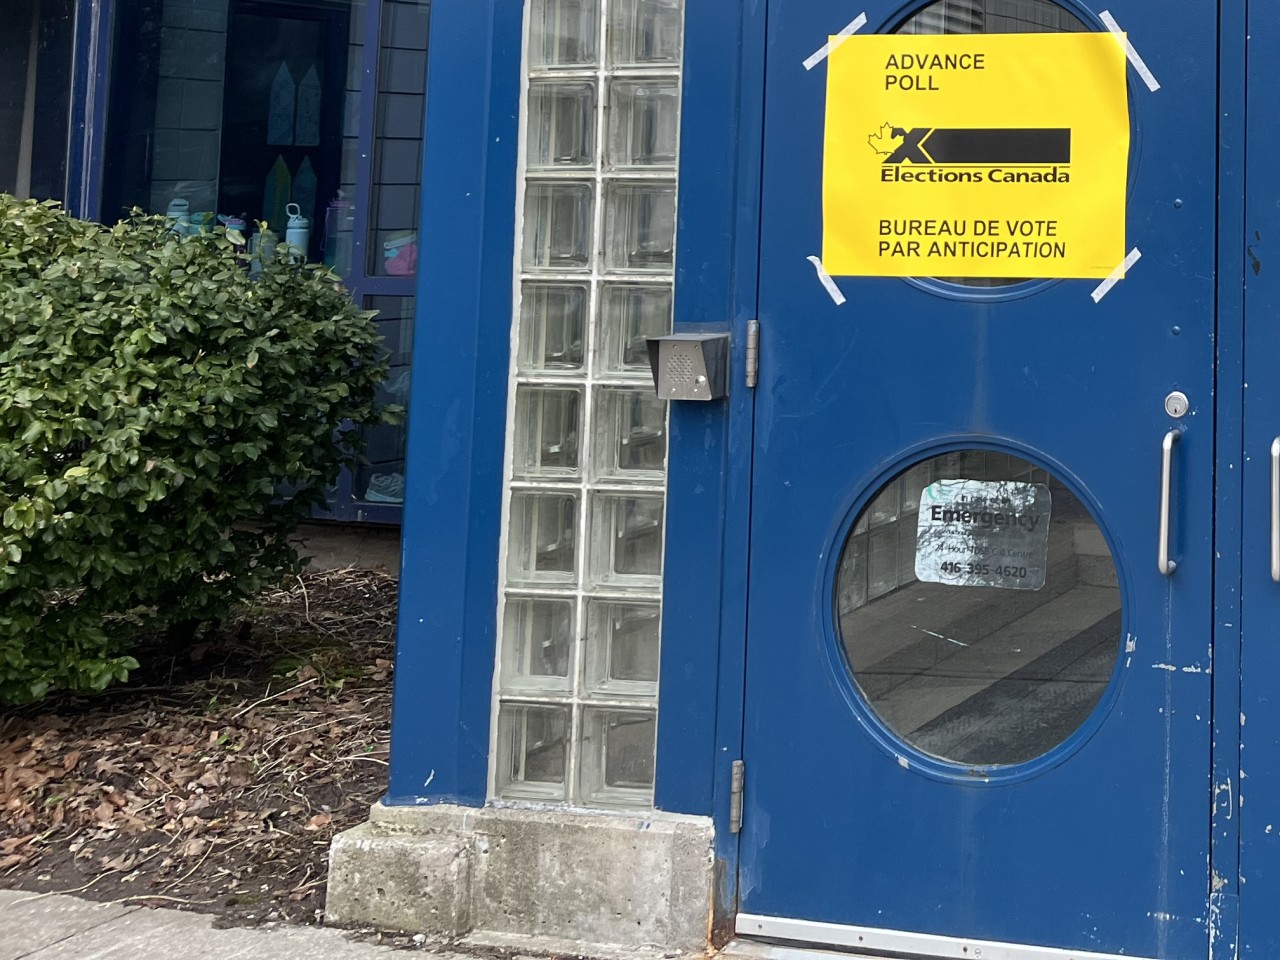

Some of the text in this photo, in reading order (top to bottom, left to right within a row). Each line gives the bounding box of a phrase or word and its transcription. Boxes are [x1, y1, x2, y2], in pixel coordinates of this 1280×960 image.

[884, 53, 985, 70] ADVANCE
[884, 75, 940, 91] POLL
[880, 166, 1071, 183] Elections Canada
[878, 220, 1058, 236] BUREAU DE VOTE
[878, 241, 1066, 258] PAR ANTICIPATION
[931, 504, 1040, 531] Emergency
[992, 547, 1006, 556] Call
[1008, 549, 1033, 558] Centre
[940, 561, 1027, 579] 416-395-4620
